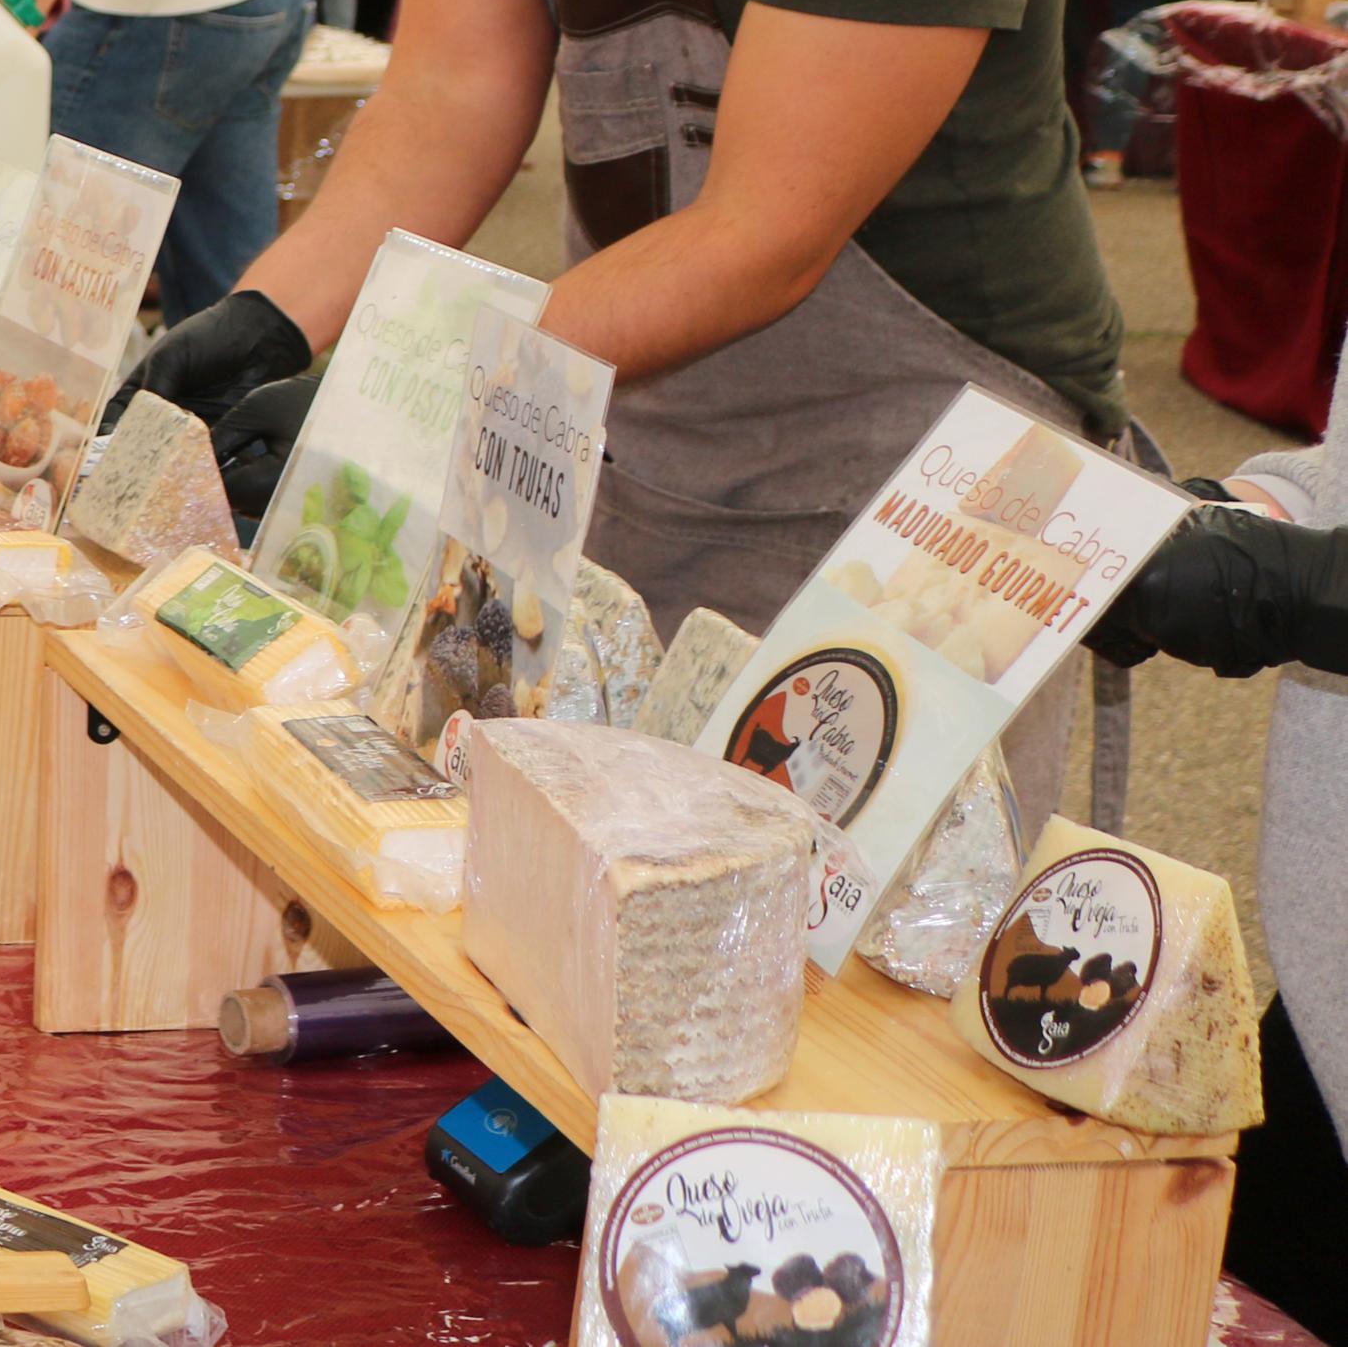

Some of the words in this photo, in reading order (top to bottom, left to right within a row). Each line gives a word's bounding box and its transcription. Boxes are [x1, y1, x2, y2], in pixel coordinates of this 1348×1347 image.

[33, 246, 61, 283] CON
[101, 231, 146, 274] Cabra
[357, 303, 415, 352] Queso
[415, 326, 443, 363] de
[359, 355, 401, 405] CON
[470, 365, 519, 422] Queso
[521, 395, 541, 434] de
[543, 405, 591, 463] Cabra
[474, 426, 507, 482] CON
[508, 445, 565, 519] TRUFAS
[920, 445, 1004, 510] Queso
[1000, 491, 1041, 533] de
[1040, 511, 1128, 581] Cabra
[873, 489, 990, 575] MADURADO
[978, 550, 1090, 634] GOURMET
[812, 669, 855, 712] Queso
[810, 711, 856, 757] Cabra
[1057, 871, 1101, 899] Queso
[1071, 897, 1117, 940] Oveja
[666, 1169, 739, 1216] Queso
[717, 1192, 790, 1244] Oveja
[779, 1213, 797, 1231] con
[792, 1197, 835, 1225] Trufa
